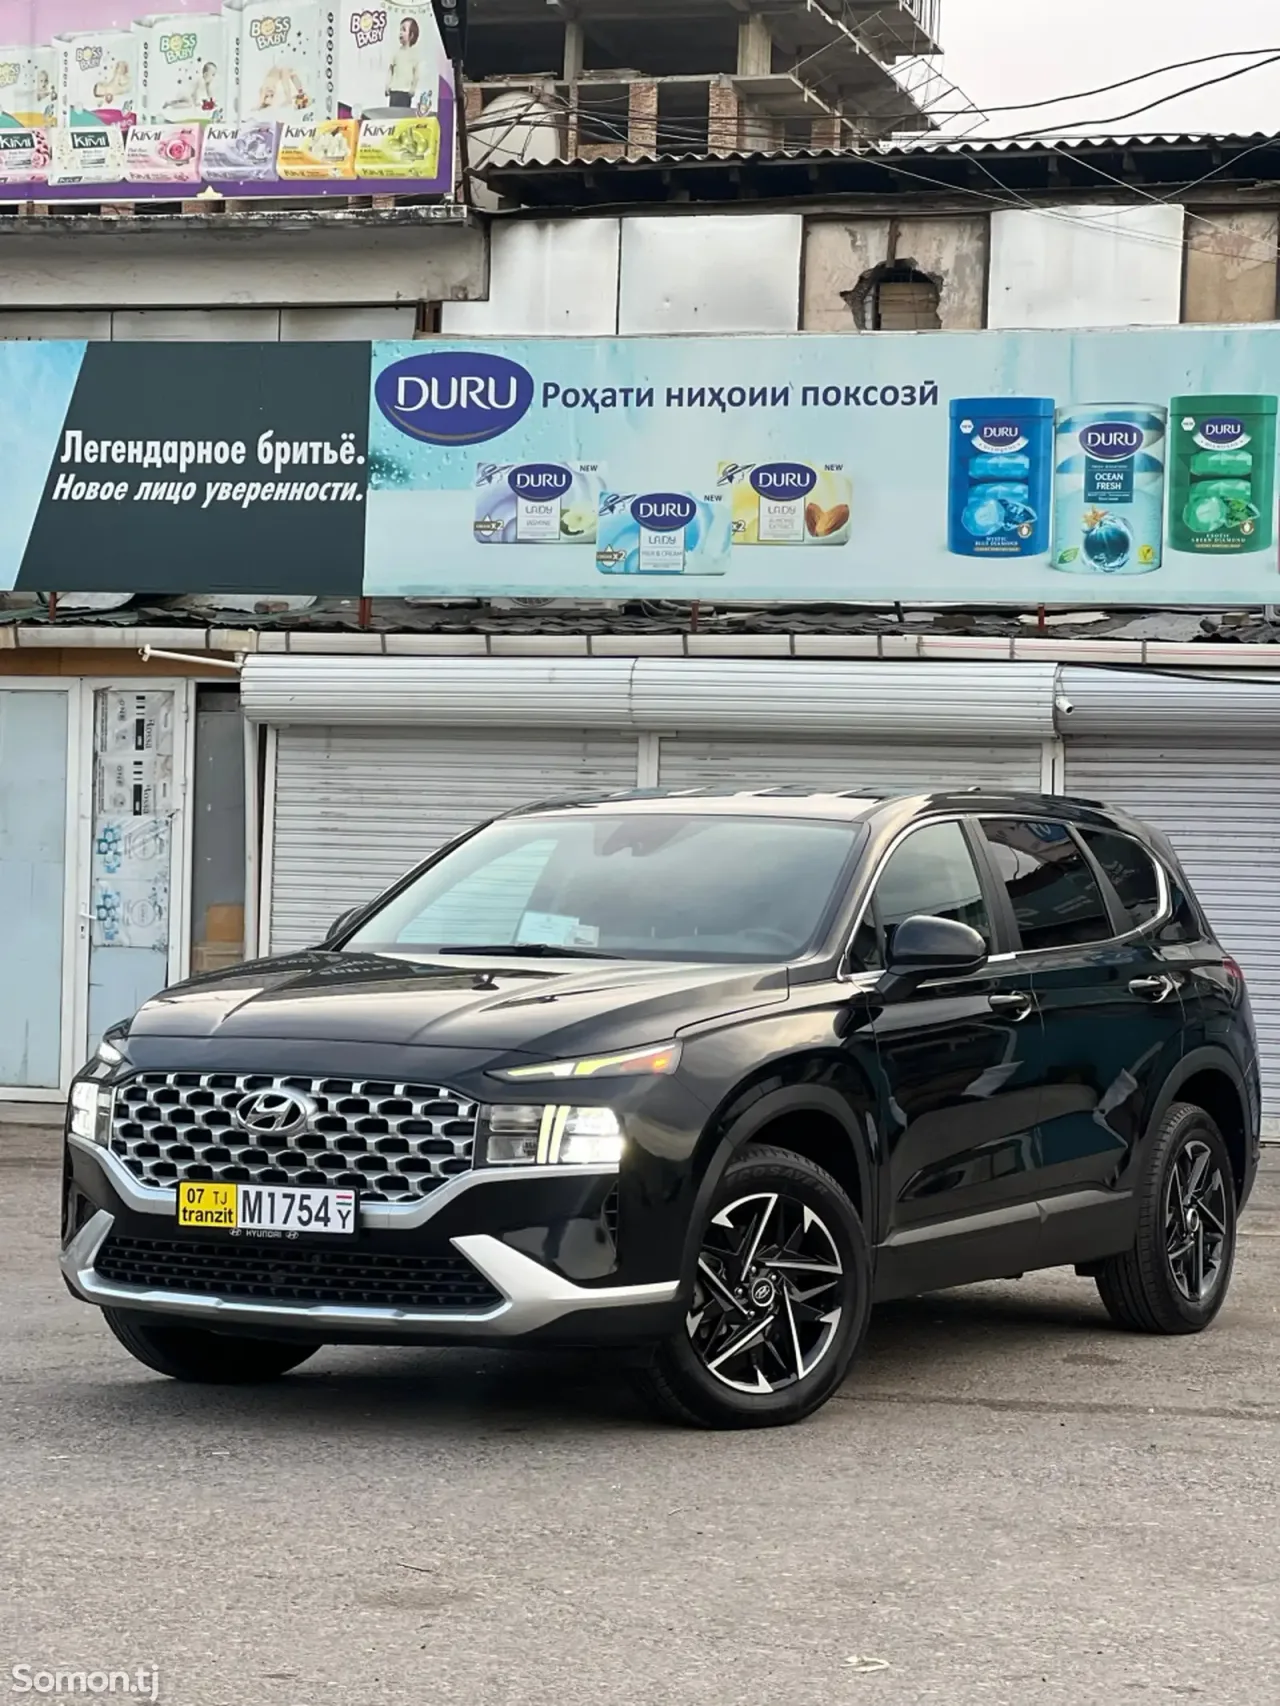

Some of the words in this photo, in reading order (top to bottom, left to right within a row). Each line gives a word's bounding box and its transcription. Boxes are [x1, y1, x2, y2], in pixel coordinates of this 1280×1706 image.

[257, 32, 287, 50] BABY
[357, 29, 384, 47] BABY
[166, 48, 193, 62] BABY
[394, 376, 517, 412] DURU
[542, 381, 654, 413] Роҳати
[665, 386, 789, 413] ниҳоии
[801, 380, 939, 407] поксозӣ
[983, 426, 1019, 438] DURU
[1206, 424, 1241, 436] DURU
[1087, 432, 1137, 447] DURU
[60, 430, 246, 473] Легендарное
[257, 430, 365, 474] бритьё.
[580, 464, 598, 472] NEW
[515, 473, 566, 489] DURU
[758, 472, 810, 488] DURU
[1095, 472, 1124, 481] OCEAN
[52, 473, 129, 501] Новое
[133, 481, 197, 504] лицо
[201, 480, 363, 509] уверенности.
[1096, 482, 1122, 490] FRESH
[639, 502, 690, 518] DURU
[187, 1188, 204, 1204] 07
[213, 1190, 228, 1205] TJ
[182, 1207, 234, 1223] tranzit
[242, 1189, 331, 1227] M1754
[337, 1209, 351, 1229] Y
[246, 1230, 282, 1239] HYUNDAI
